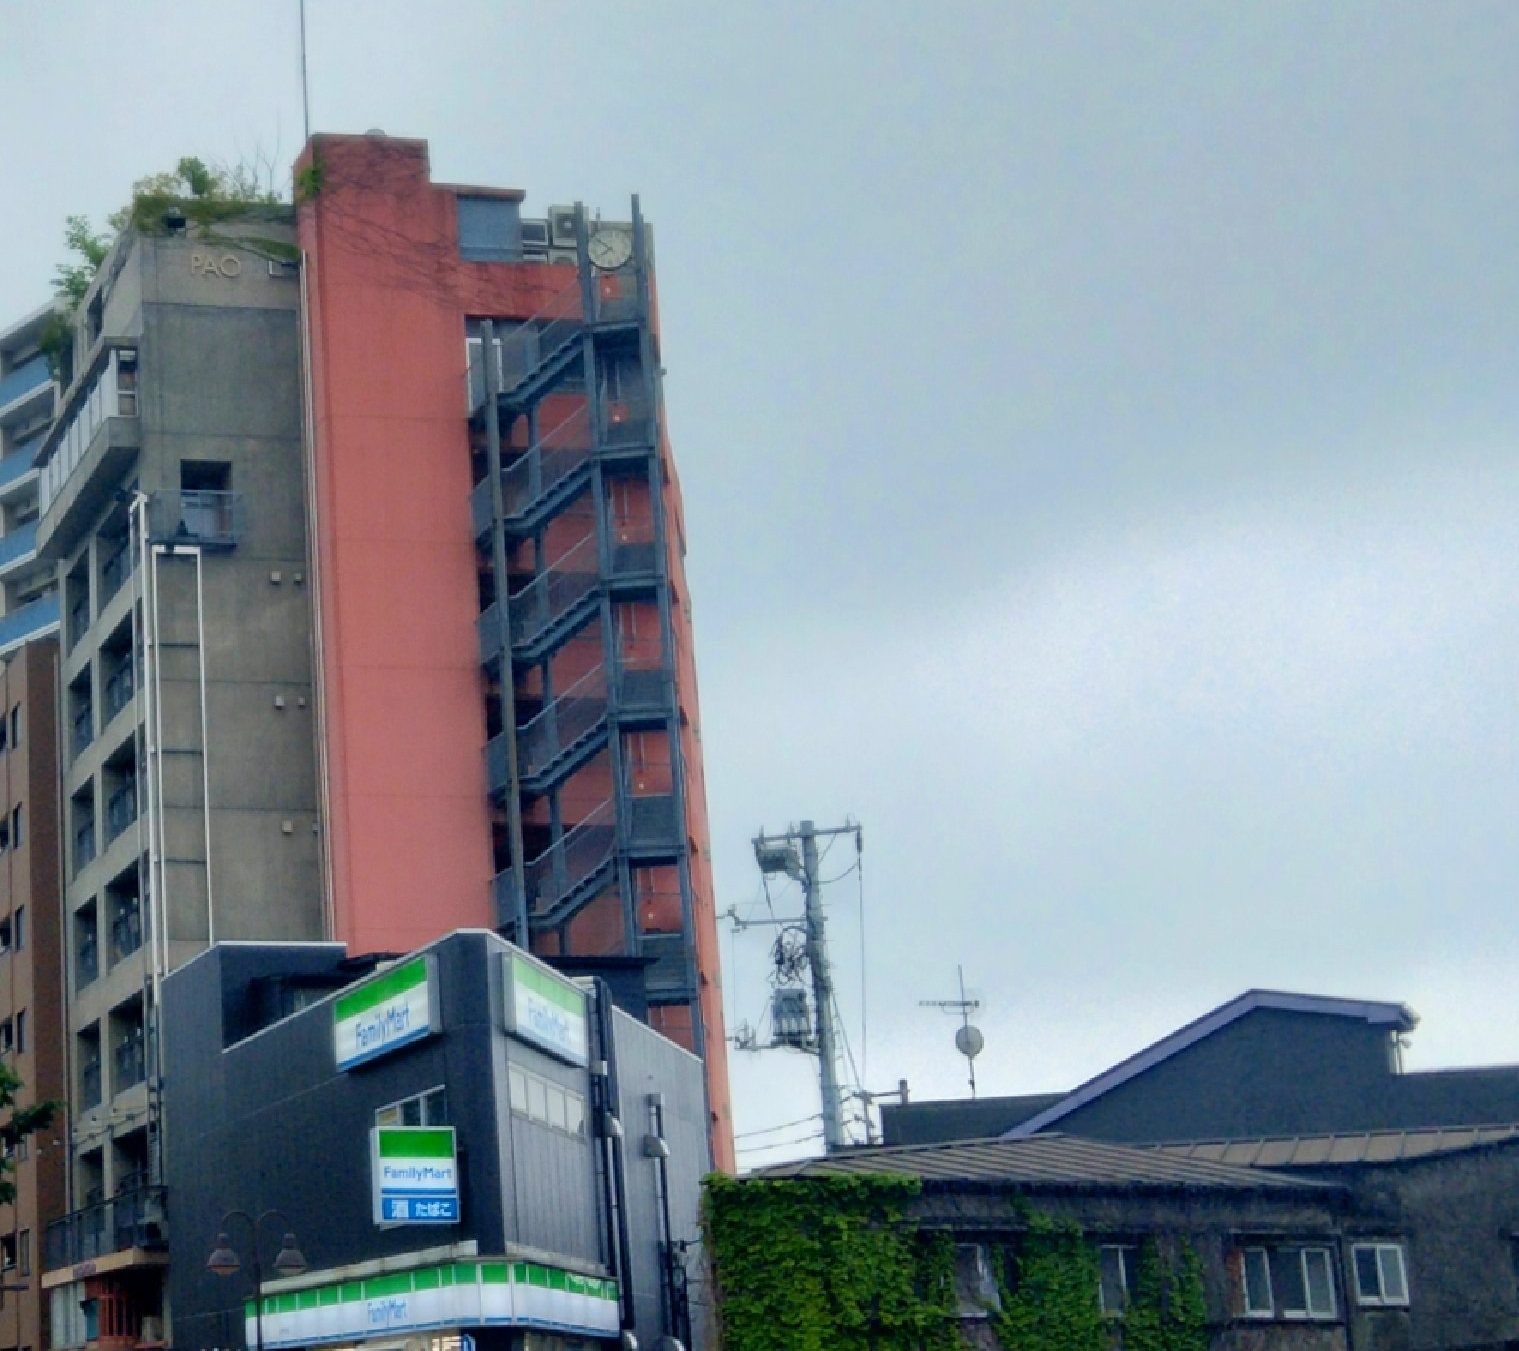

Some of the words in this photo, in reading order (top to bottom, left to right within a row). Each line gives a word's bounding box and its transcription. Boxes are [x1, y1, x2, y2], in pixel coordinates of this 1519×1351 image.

[356, 1001, 408, 1049] FamilyMart
[384, 1165, 452, 1181] FamilyMart
[367, 1298, 407, 1326] FamilyMart
